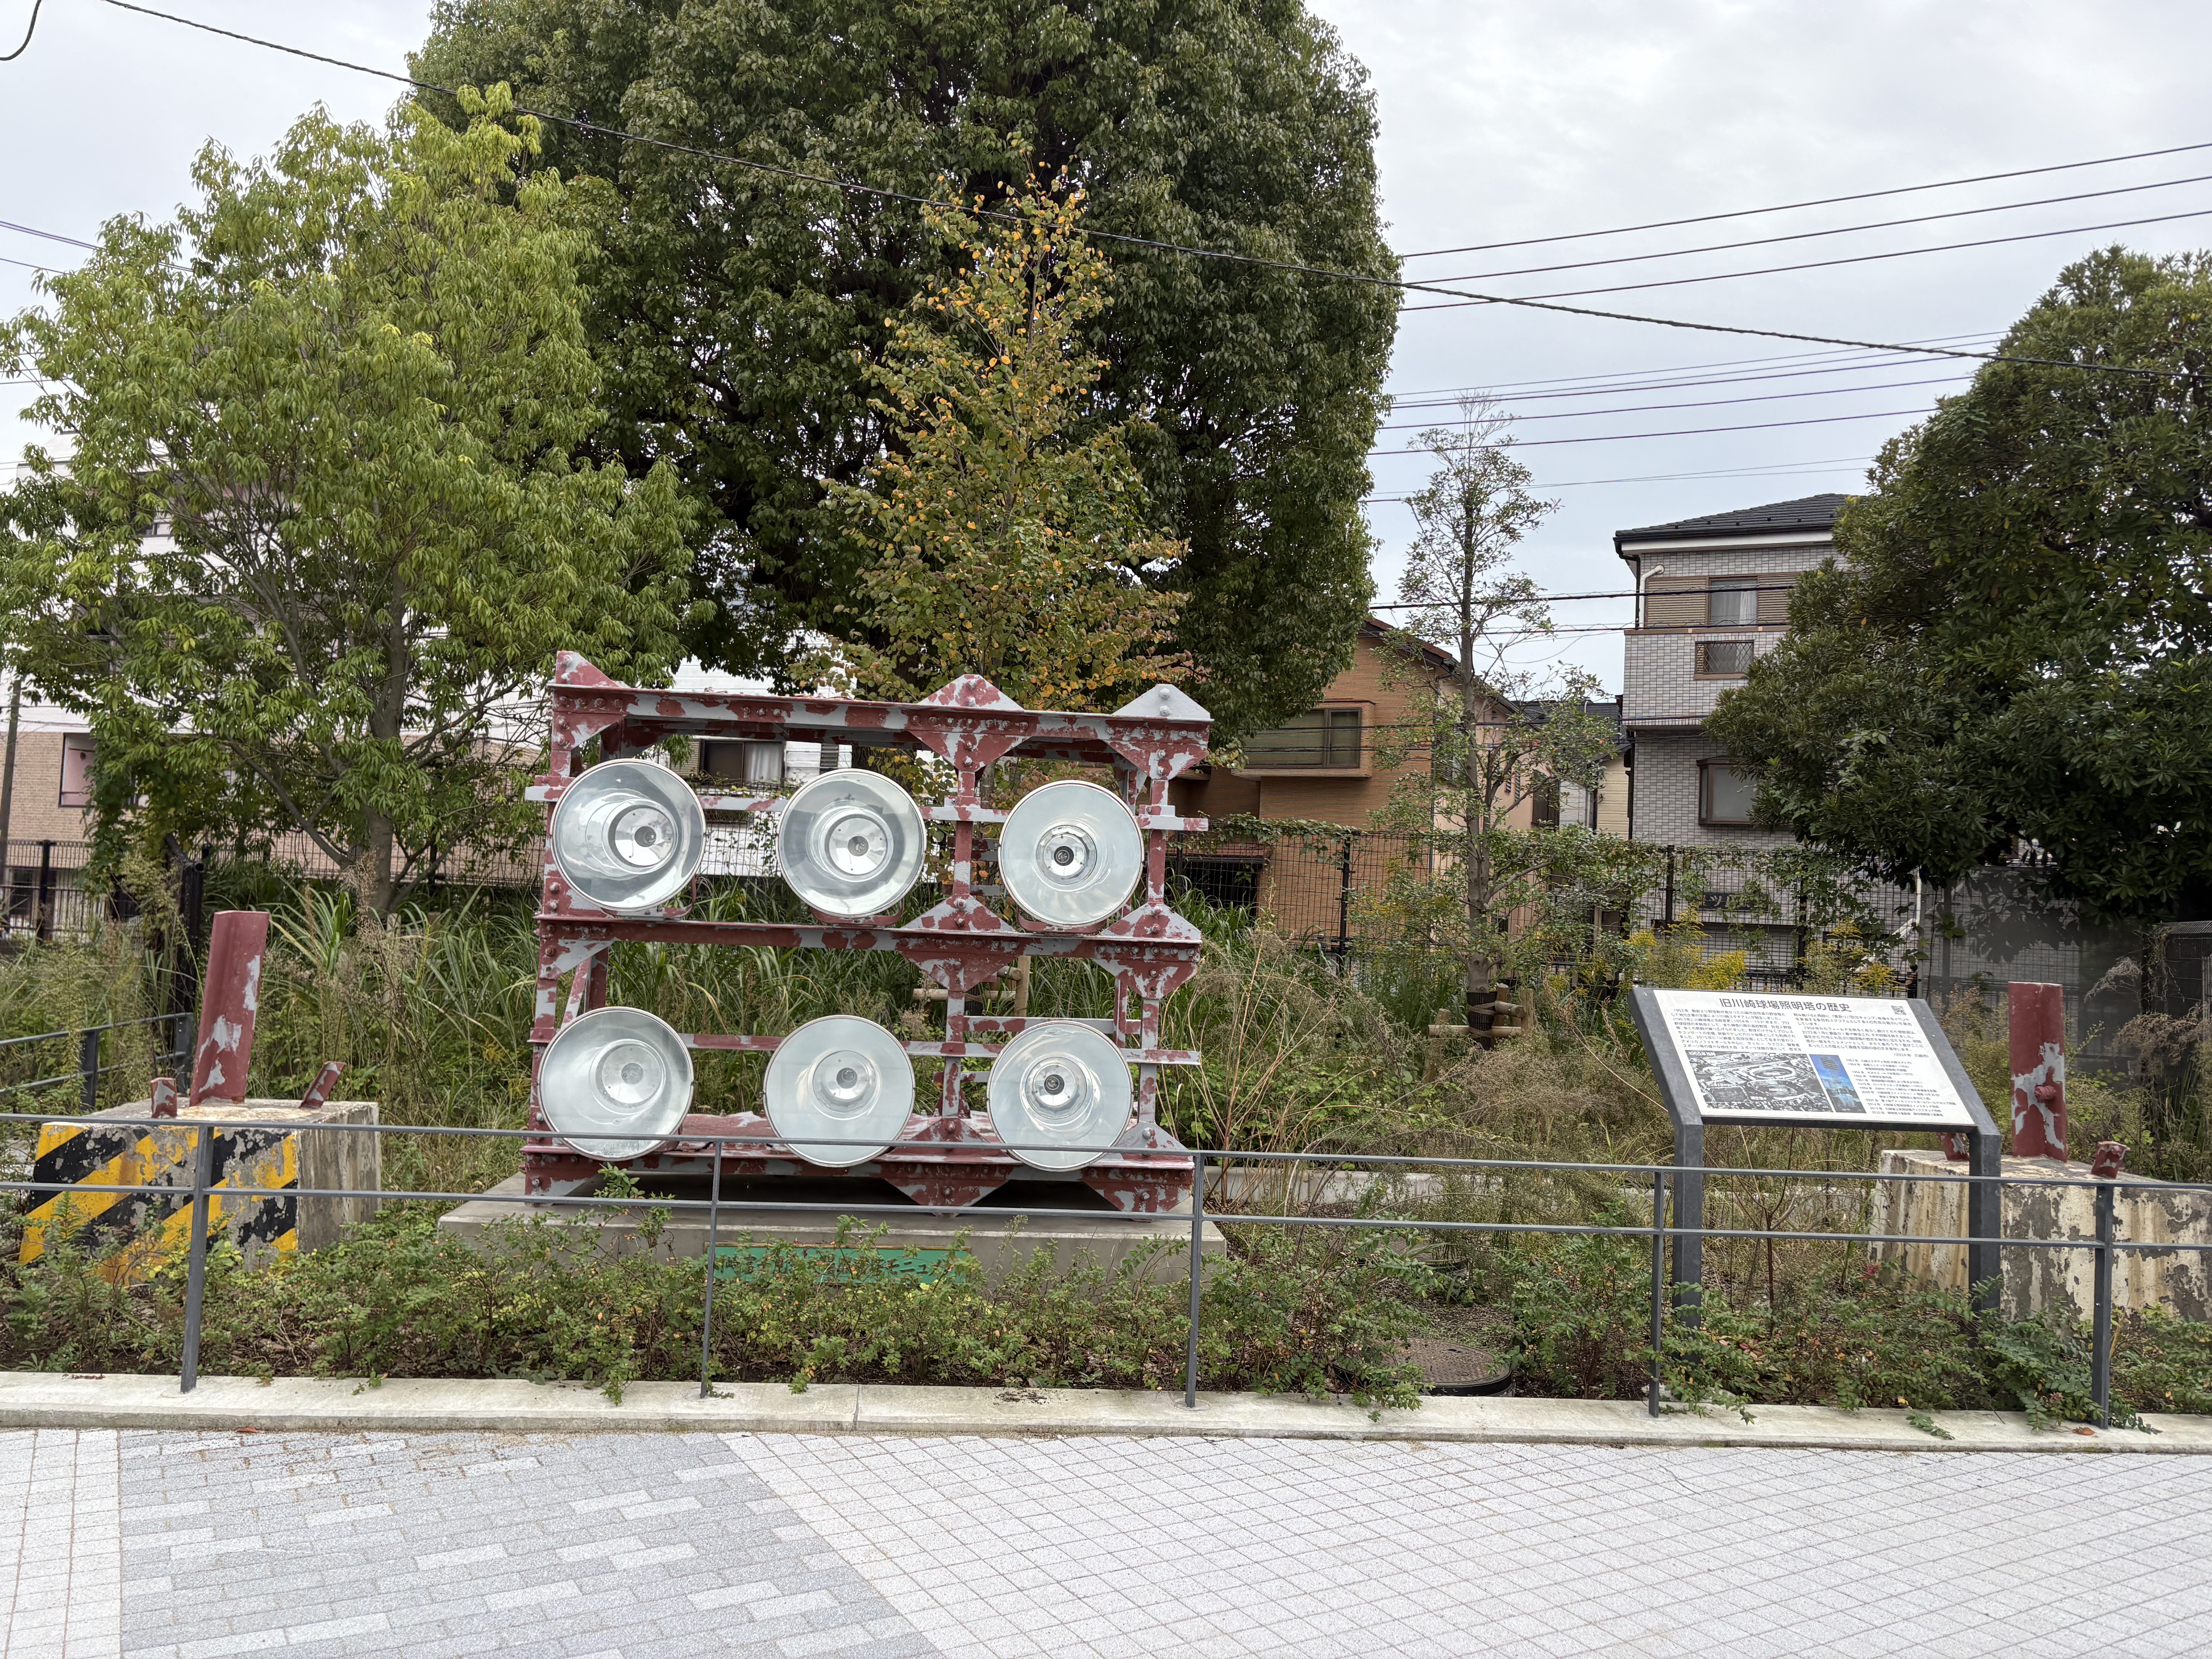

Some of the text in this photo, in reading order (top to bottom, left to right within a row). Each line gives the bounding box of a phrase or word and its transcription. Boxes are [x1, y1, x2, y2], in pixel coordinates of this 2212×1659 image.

[1719, 998, 1852, 1012] 旧川崎球場照明塔の歴史
